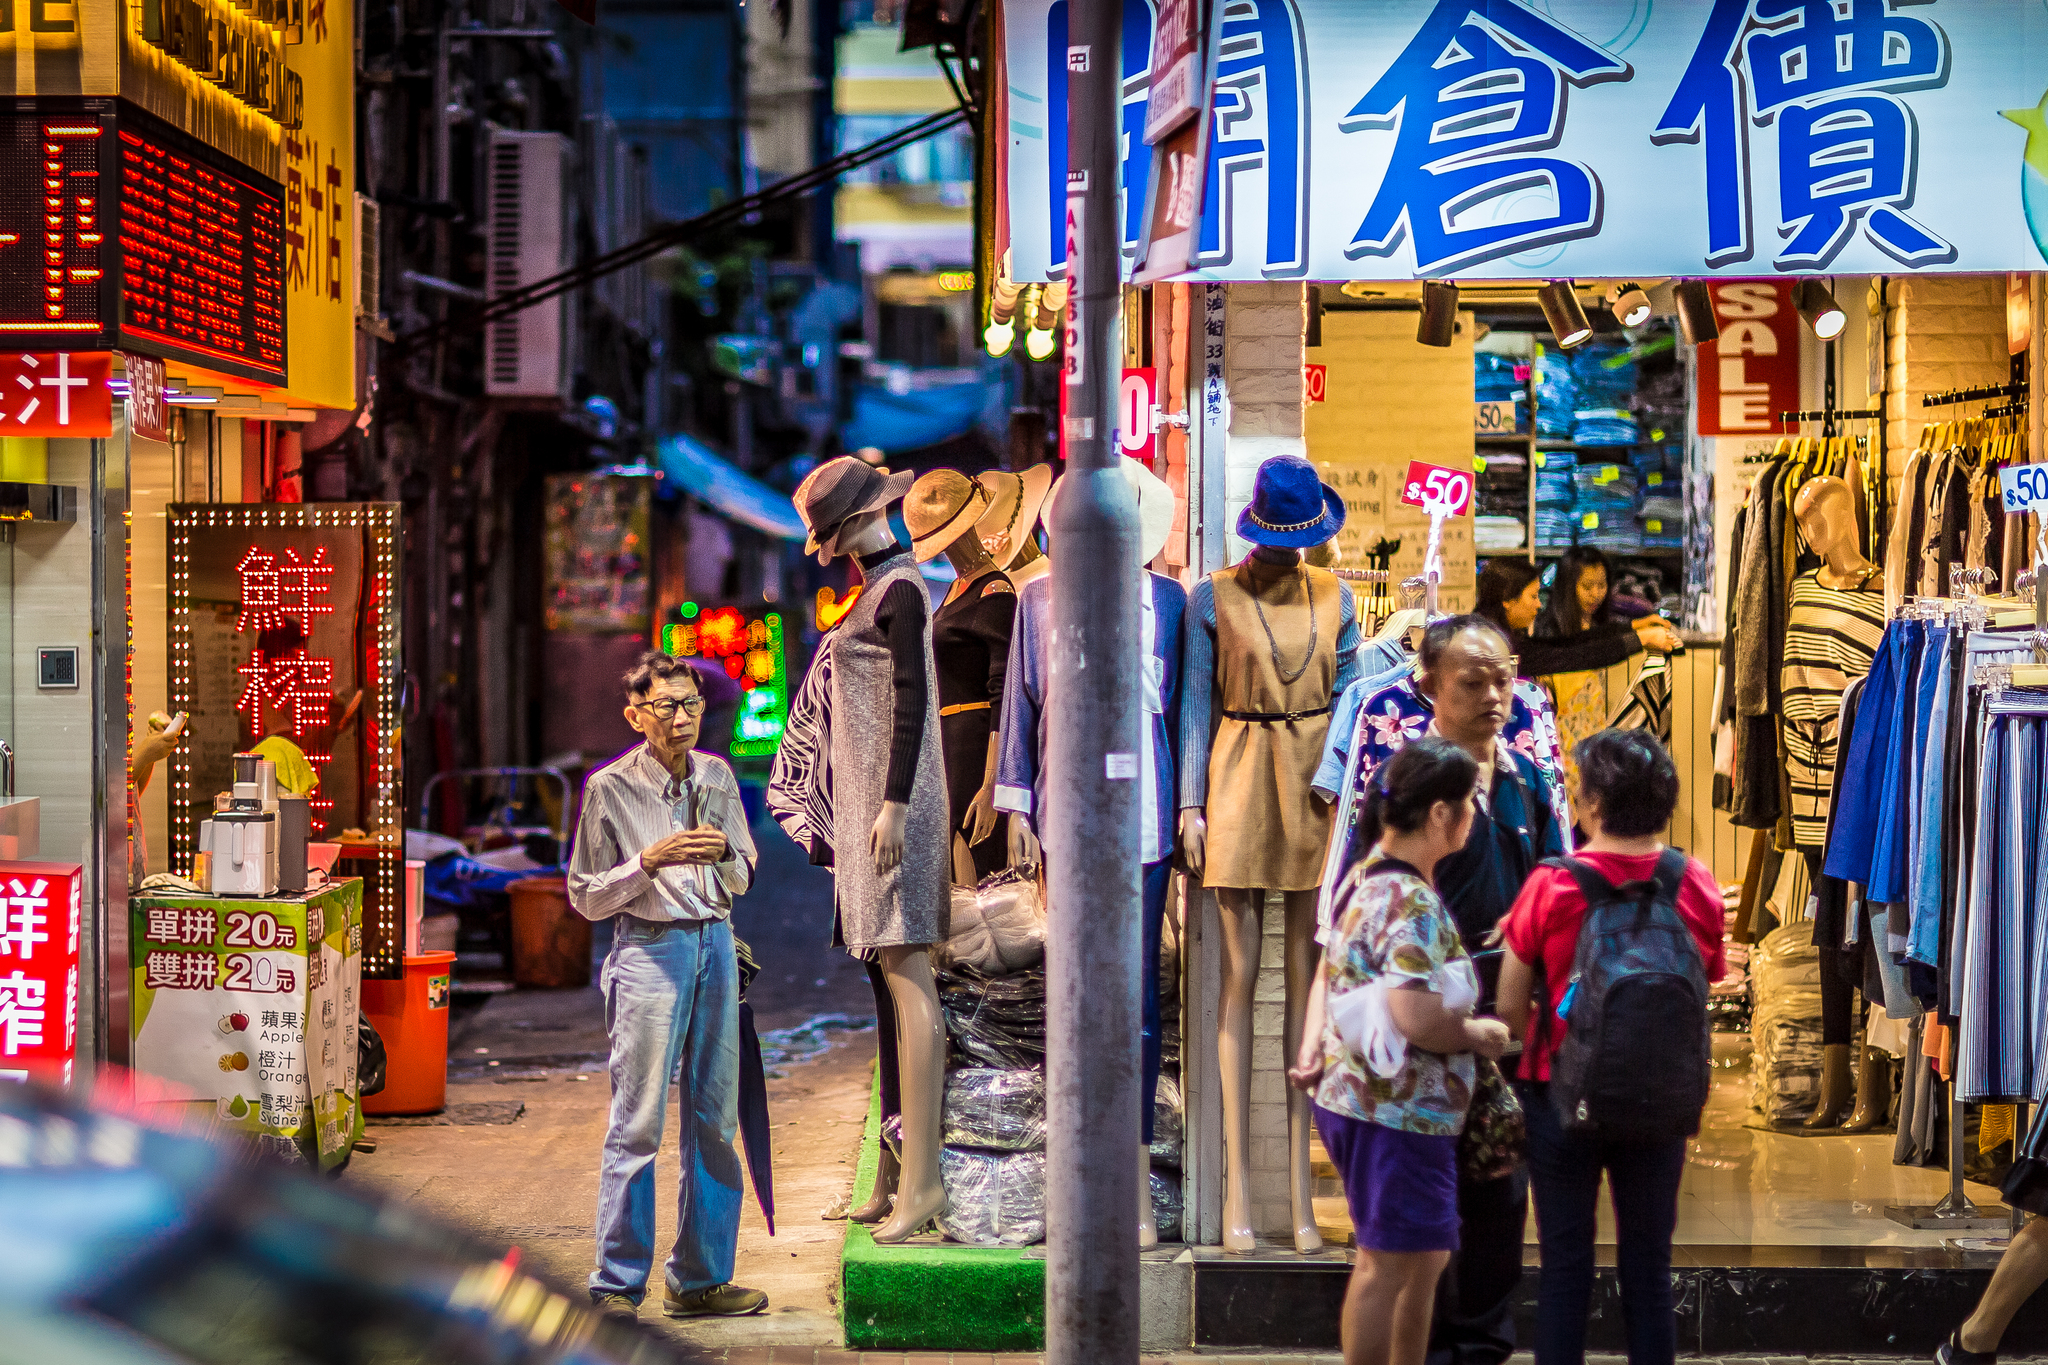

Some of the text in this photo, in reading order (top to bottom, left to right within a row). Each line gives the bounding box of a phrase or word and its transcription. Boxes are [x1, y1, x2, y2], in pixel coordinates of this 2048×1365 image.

[1045, 0, 1958, 280] 開倉價
[1717, 282, 1779, 431] SALE
[0, 352, 89, 425] 汁
[1407, 468, 1469, 511] $50
[2006, 467, 2048, 507] $50
[146, 909, 217, 946] 單拼
[224, 912, 295, 948] 20元
[146, 951, 217, 989] 雙拼
[259, 1030, 304, 1044] Apple
[258, 1050, 296, 1069] 橙汁
[260, 1093, 306, 1113] 雪梨汁
